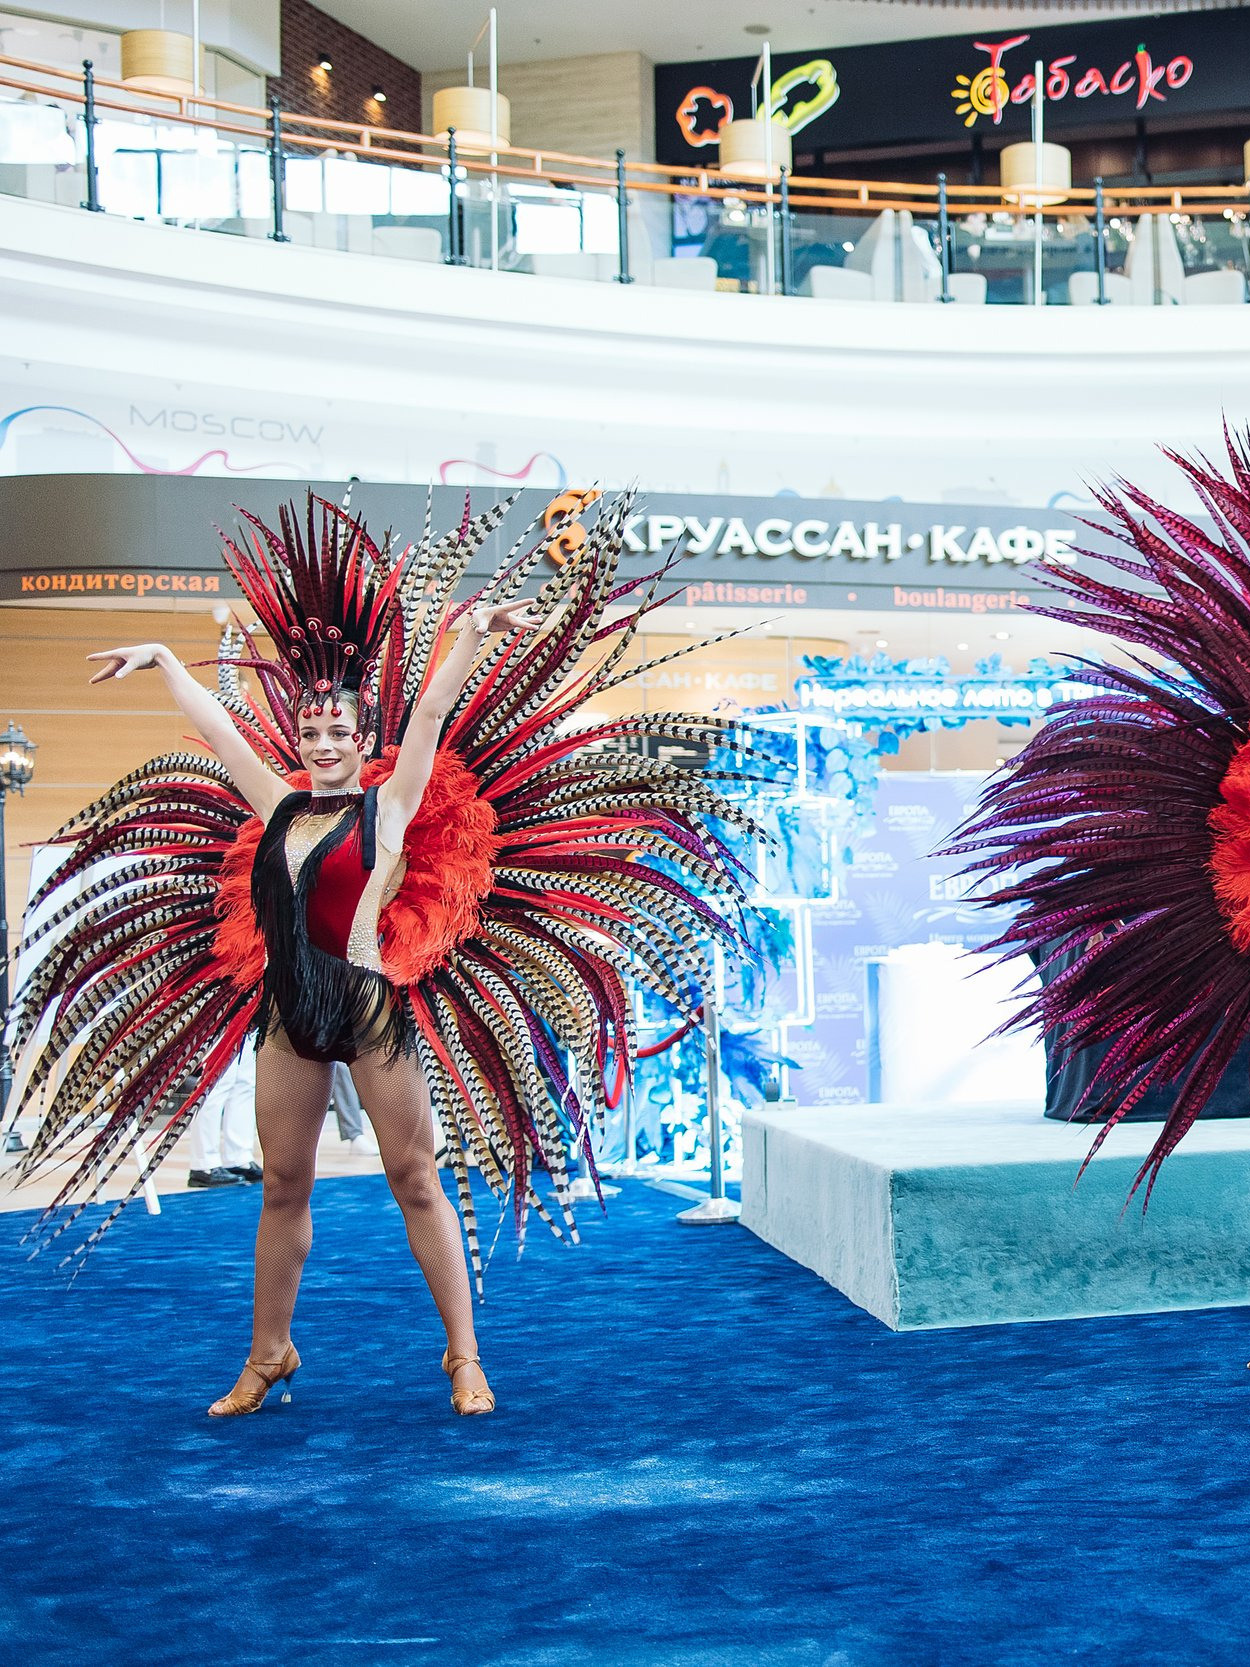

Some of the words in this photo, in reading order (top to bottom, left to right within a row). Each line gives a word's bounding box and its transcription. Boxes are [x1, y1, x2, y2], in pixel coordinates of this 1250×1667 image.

[973, 34, 1193, 125] Табаско
[129, 404, 325, 444] MOSCOW
[930, 525, 1078, 566] КАФЕ
[20, 573, 220, 593] кондитерская
[686, 580, 807, 606] pâtisserie
[929, 872, 1019, 901] ЕВРОП
